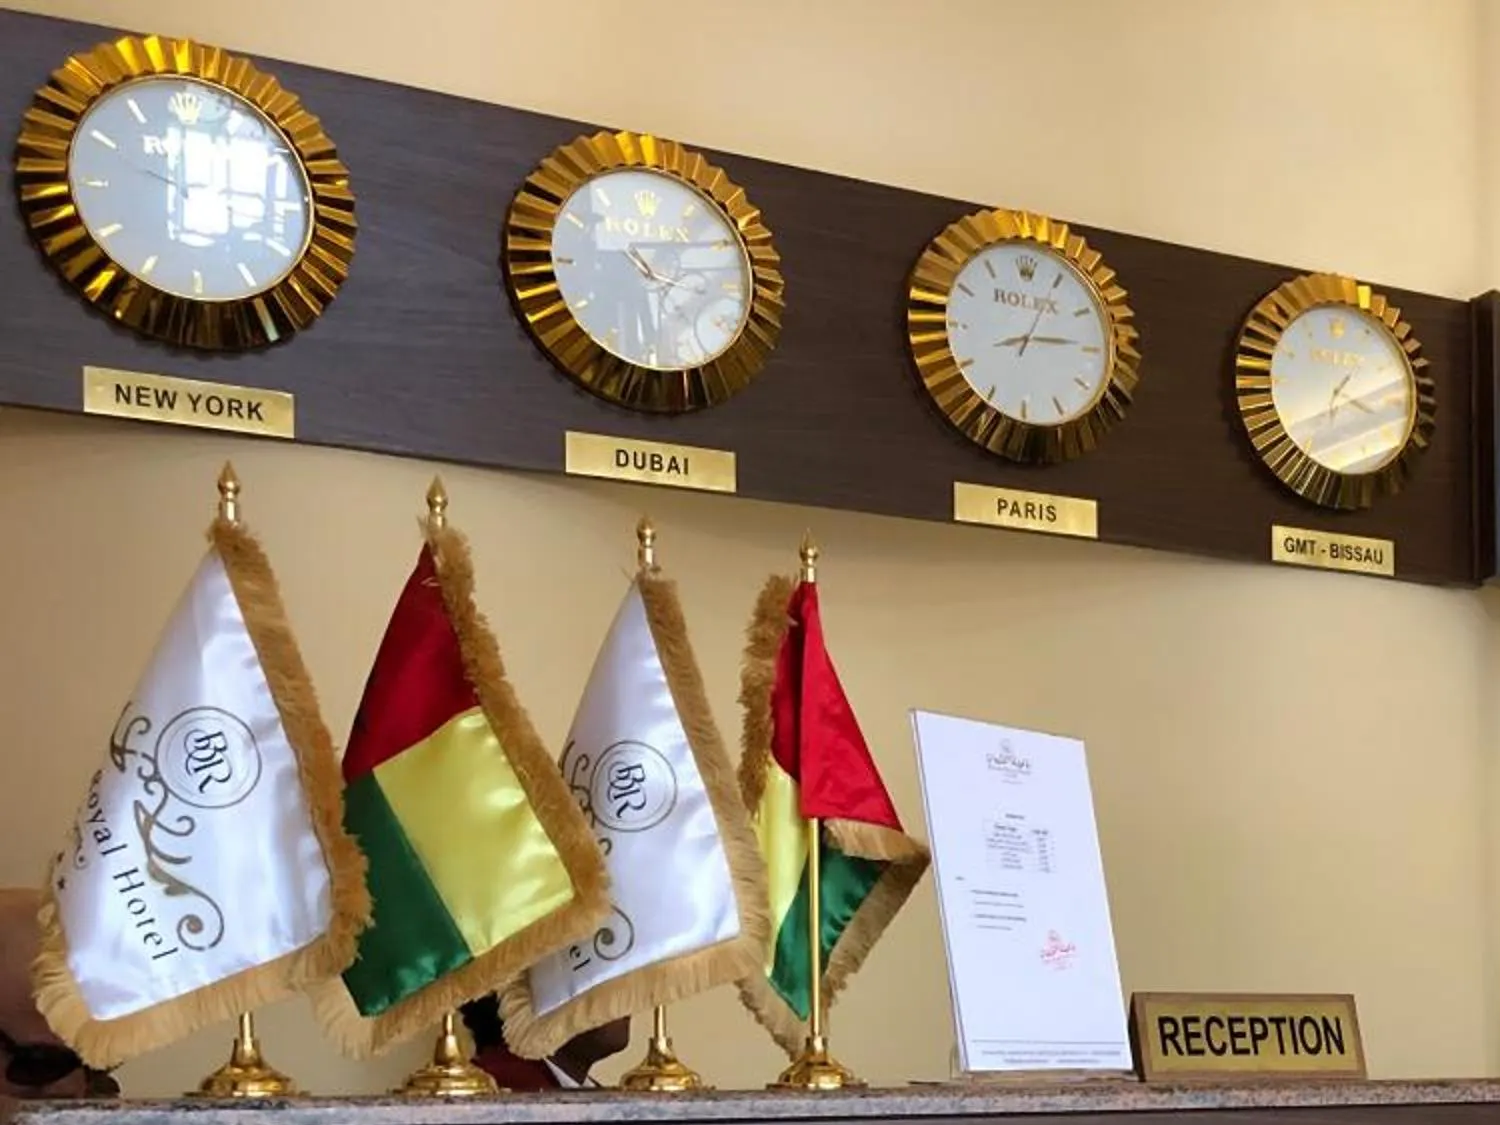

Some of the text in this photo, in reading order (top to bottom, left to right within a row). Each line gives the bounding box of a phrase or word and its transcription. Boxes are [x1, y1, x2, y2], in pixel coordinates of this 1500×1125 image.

[993, 287, 1059, 316] ROLEX
[114, 383, 264, 422] NEW YORK
[615, 449, 690, 476] DUBAI
[997, 497, 1057, 523] PARIS
[1283, 537, 1317, 556] GMT
[1329, 543, 1384, 565] BISSAU
[112, 866, 179, 961] Hotel
[1157, 1014, 1346, 1057] RECEPTION
